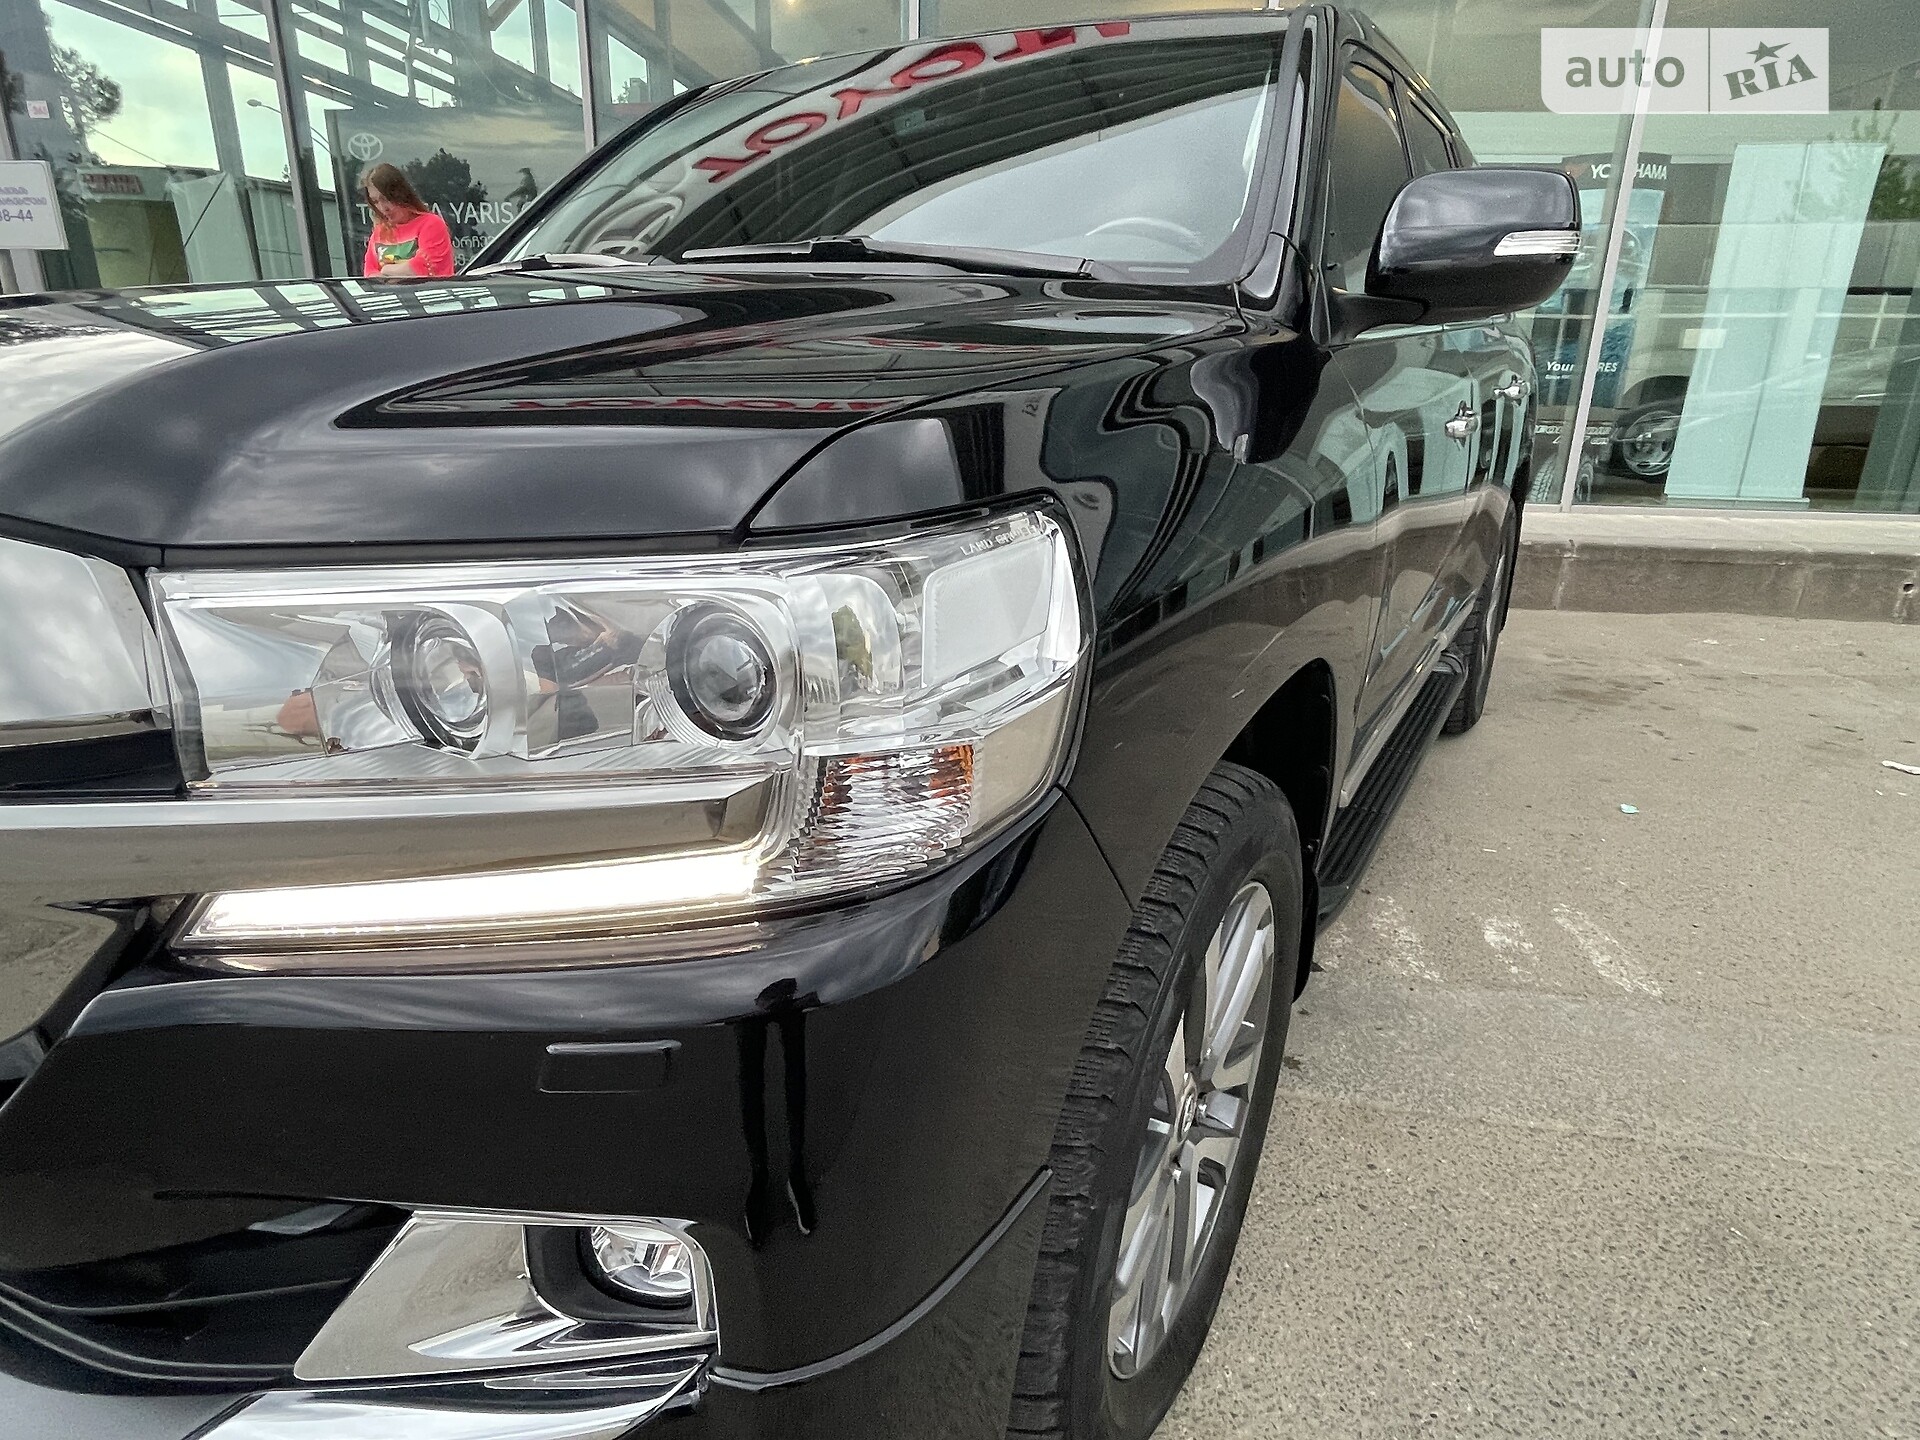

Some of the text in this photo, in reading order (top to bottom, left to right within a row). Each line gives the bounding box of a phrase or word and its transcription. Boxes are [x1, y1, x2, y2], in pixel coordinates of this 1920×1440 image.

[1591, 163, 1668, 180] YOHAMA
[450, 201, 514, 224] YARIS
[960, 539, 993, 556] LAND
